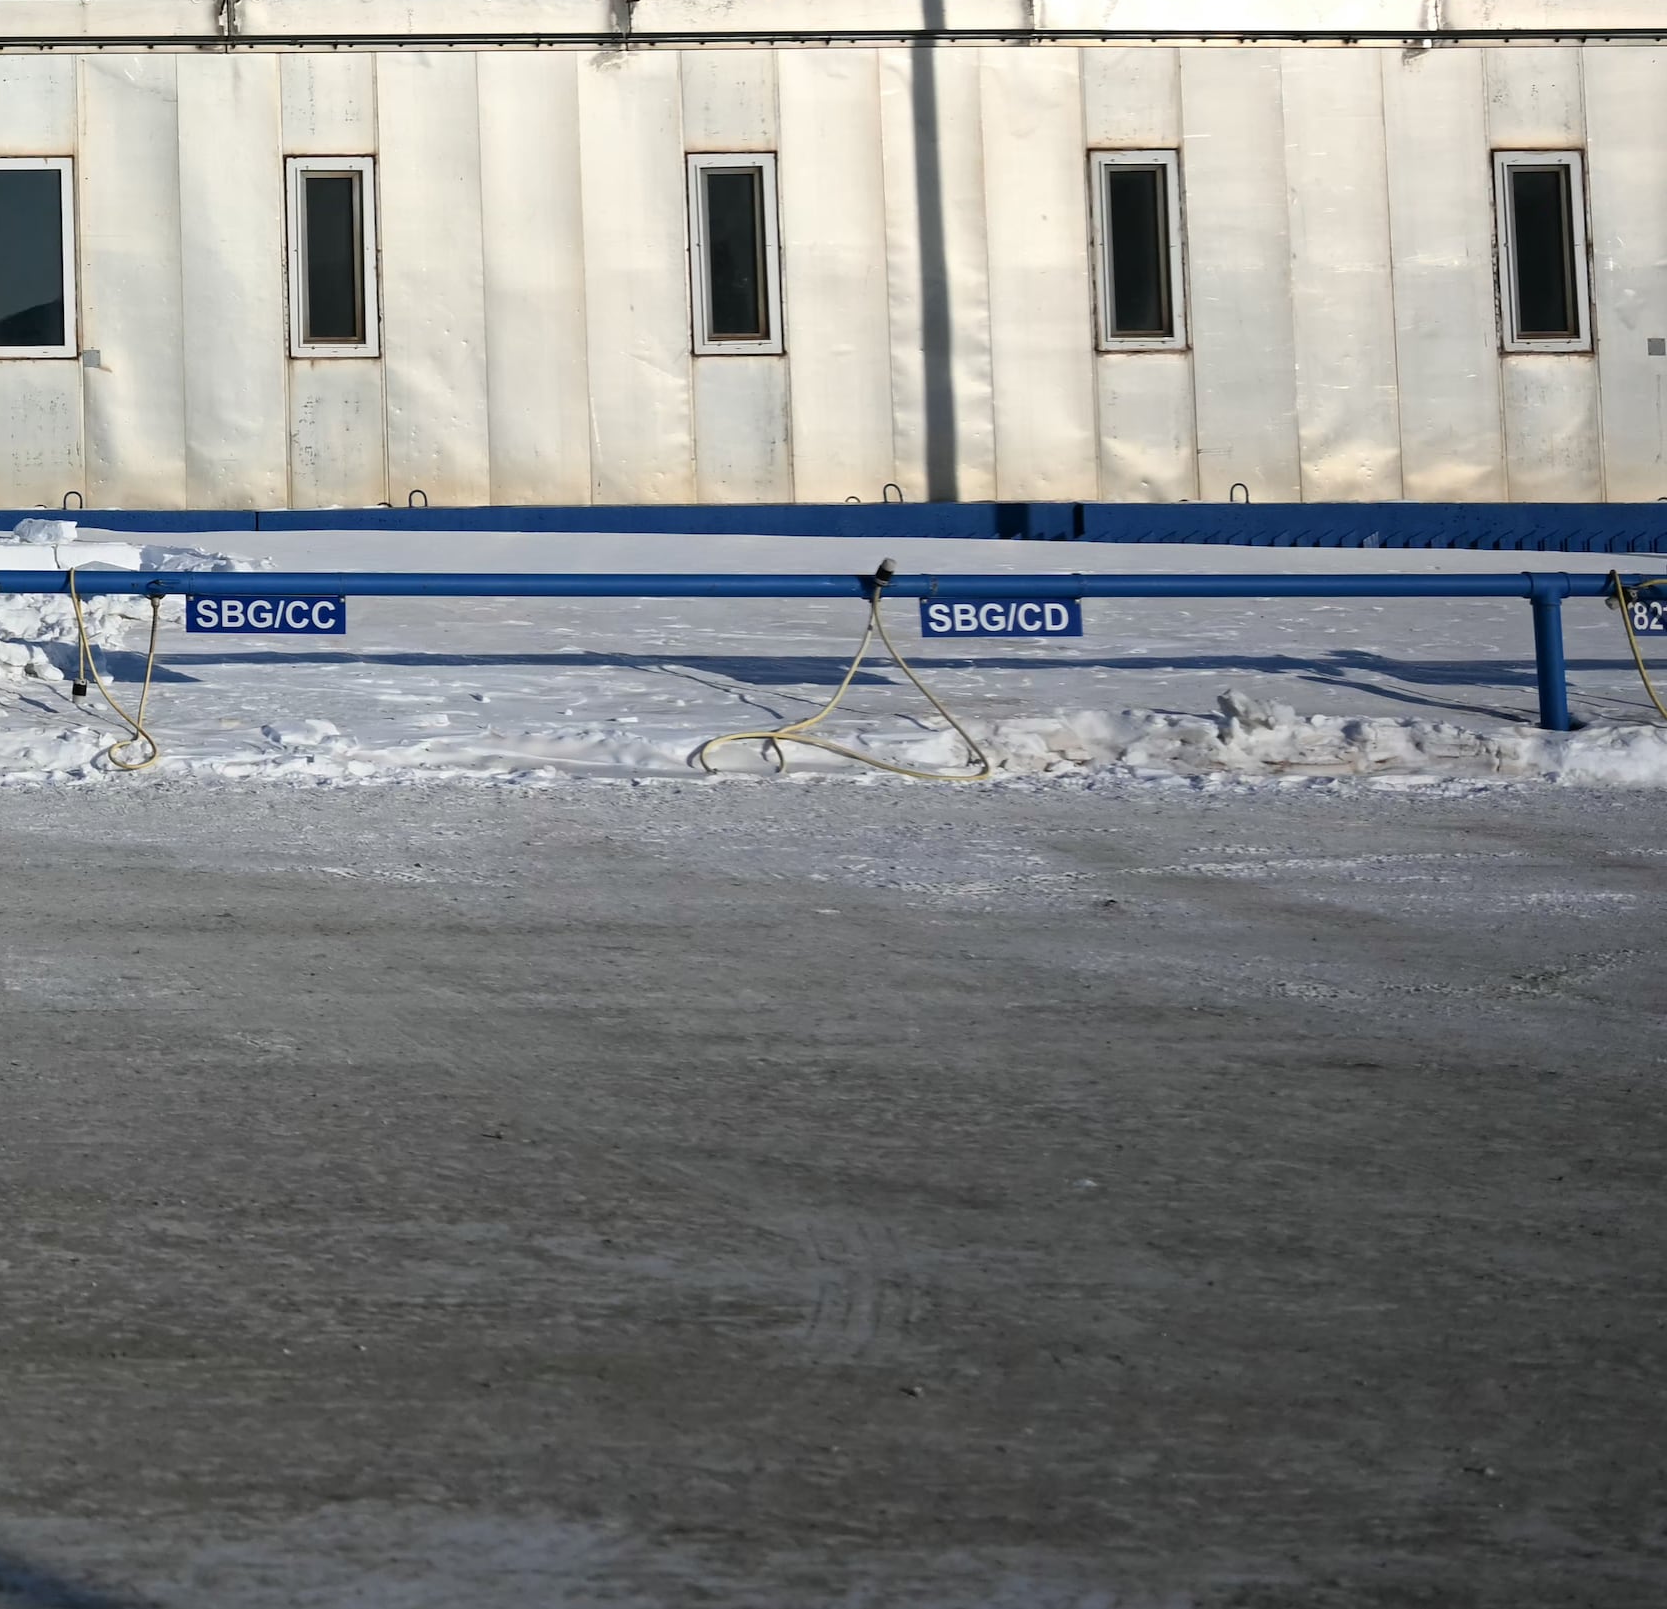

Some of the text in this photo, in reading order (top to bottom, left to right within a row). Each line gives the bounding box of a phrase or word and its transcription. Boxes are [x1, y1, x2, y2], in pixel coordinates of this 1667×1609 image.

[195, 599, 336, 629] SBG/CC
[928, 602, 1069, 633] SBG/CD
[1633, 601, 1667, 631] 82
